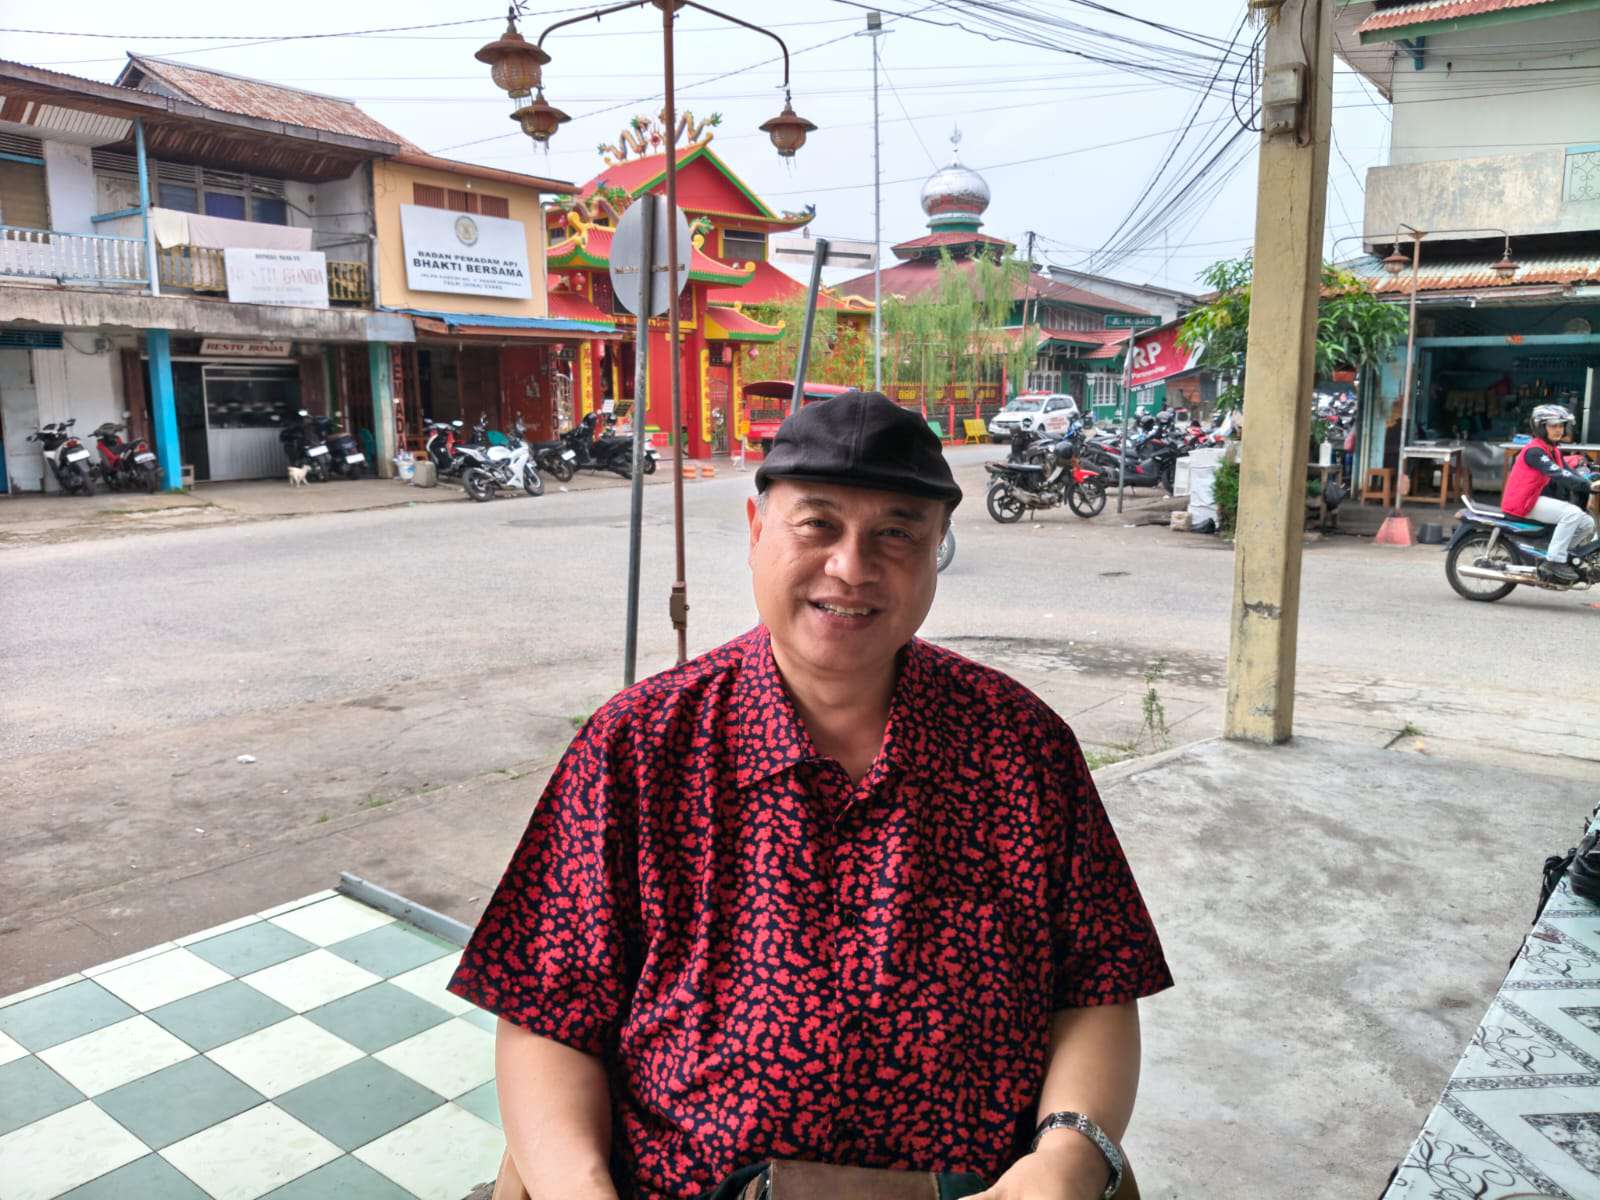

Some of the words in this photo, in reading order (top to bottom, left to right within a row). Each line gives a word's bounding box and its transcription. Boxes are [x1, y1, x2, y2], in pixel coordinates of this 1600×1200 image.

[413, 258, 462, 271] BHAKTI
[466, 264, 524, 278] BERSAMA
[417, 250, 452, 260] BADAN
[454, 255, 500, 265] PEMADAM
[503, 260, 518, 269] API
